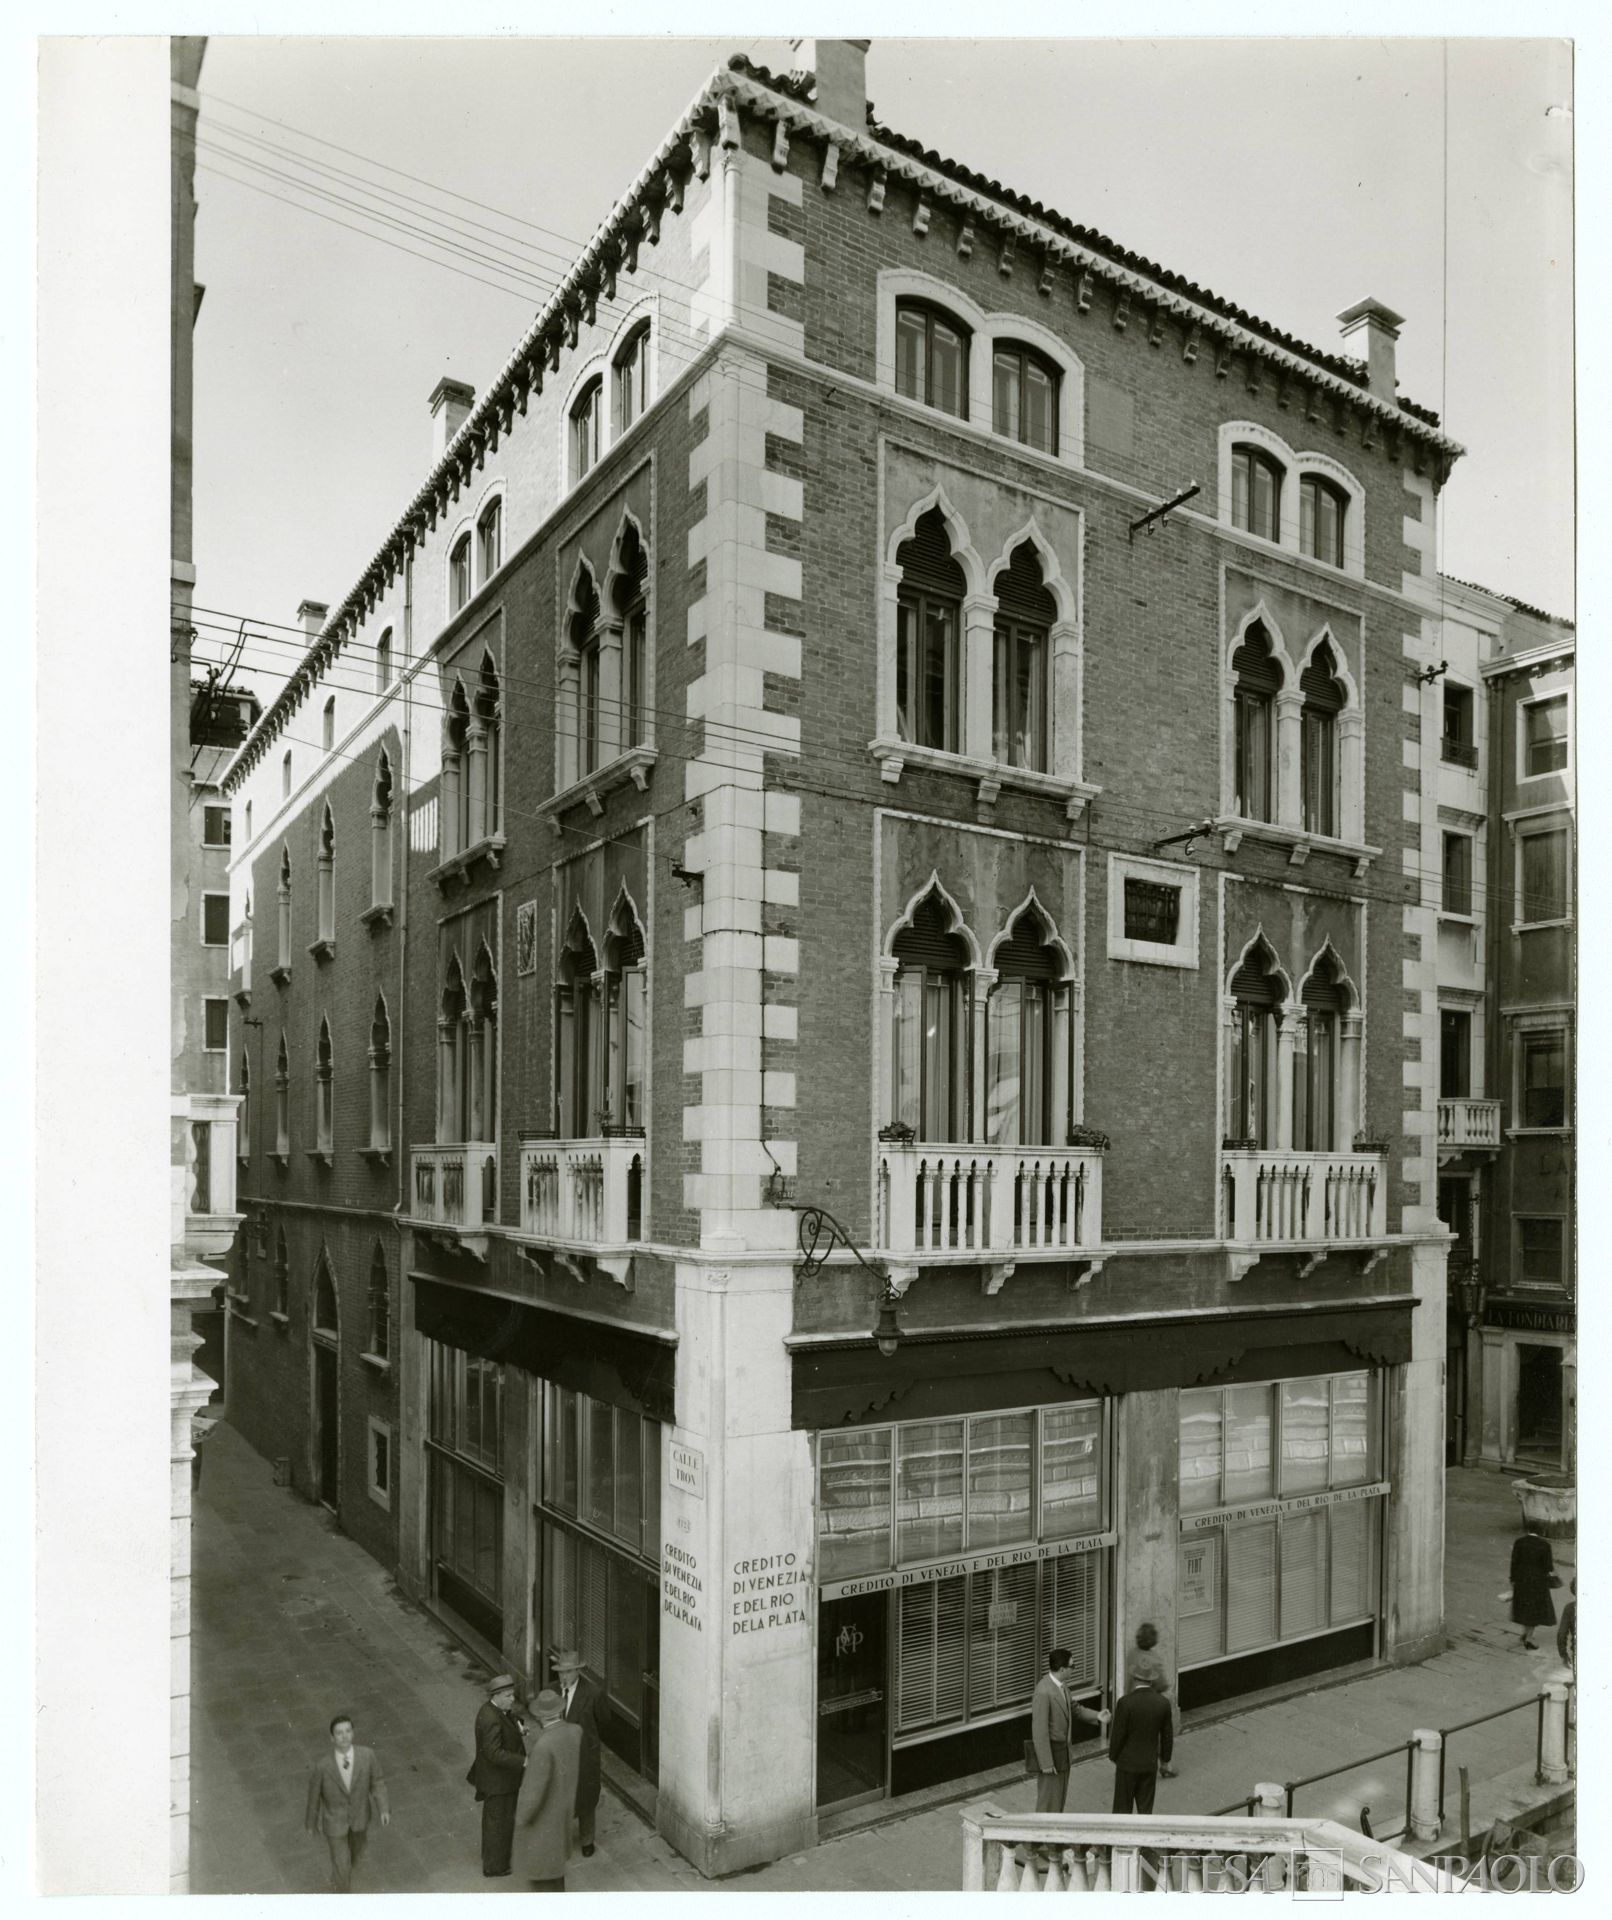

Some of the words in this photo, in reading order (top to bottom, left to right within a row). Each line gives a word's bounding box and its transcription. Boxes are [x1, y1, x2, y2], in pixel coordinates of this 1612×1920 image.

[673, 1449, 699, 1470] CALLE
[676, 1468, 696, 1485] TRON
[1194, 1513, 1233, 1528] CREDITO
[1237, 1510, 1246, 1520] DI
[1250, 1504, 1283, 1517] VENEZIA
[1287, 1502, 1291, 1511] E
[1297, 1498, 1312, 1509] DEL
[1314, 1495, 1329, 1504] RIO
[1333, 1493, 1344, 1503] DE
[1347, 1491, 1357, 1499] LA
[1360, 1486, 1381, 1498] PLATA
[664, 1543, 697, 1569] CREDITO
[733, 1552, 796, 1575] CREDITO
[841, 1577, 894, 1596] CREDITO
[902, 1573, 913, 1584] DI
[921, 1563, 966, 1579] VENEZIA
[973, 1560, 979, 1571] E
[987, 1556, 1006, 1568] DEL
[1012, 1550, 1032, 1562] RIO
[1038, 1547, 1050, 1558] DE
[1058, 1545, 1069, 1554] LA
[1076, 1538, 1103, 1551] PLATA
[1187, 1557, 1203, 1575] FIAT
[664, 1560, 672, 1575] DI
[672, 1563, 702, 1592] VENEZIA
[733, 1581, 745, 1595] DI
[749, 1569, 806, 1591] VENEZIA
[664, 1580, 669, 1594] E
[669, 1583, 682, 1602] DEL
[682, 1590, 696, 1609] RIO
[733, 1602, 741, 1616] E
[743, 1597, 767, 1614] DEL
[770, 1592, 794, 1608] RIO
[682, 1609, 702, 1632] PLATA
[768, 1609, 806, 1628] PLATA
